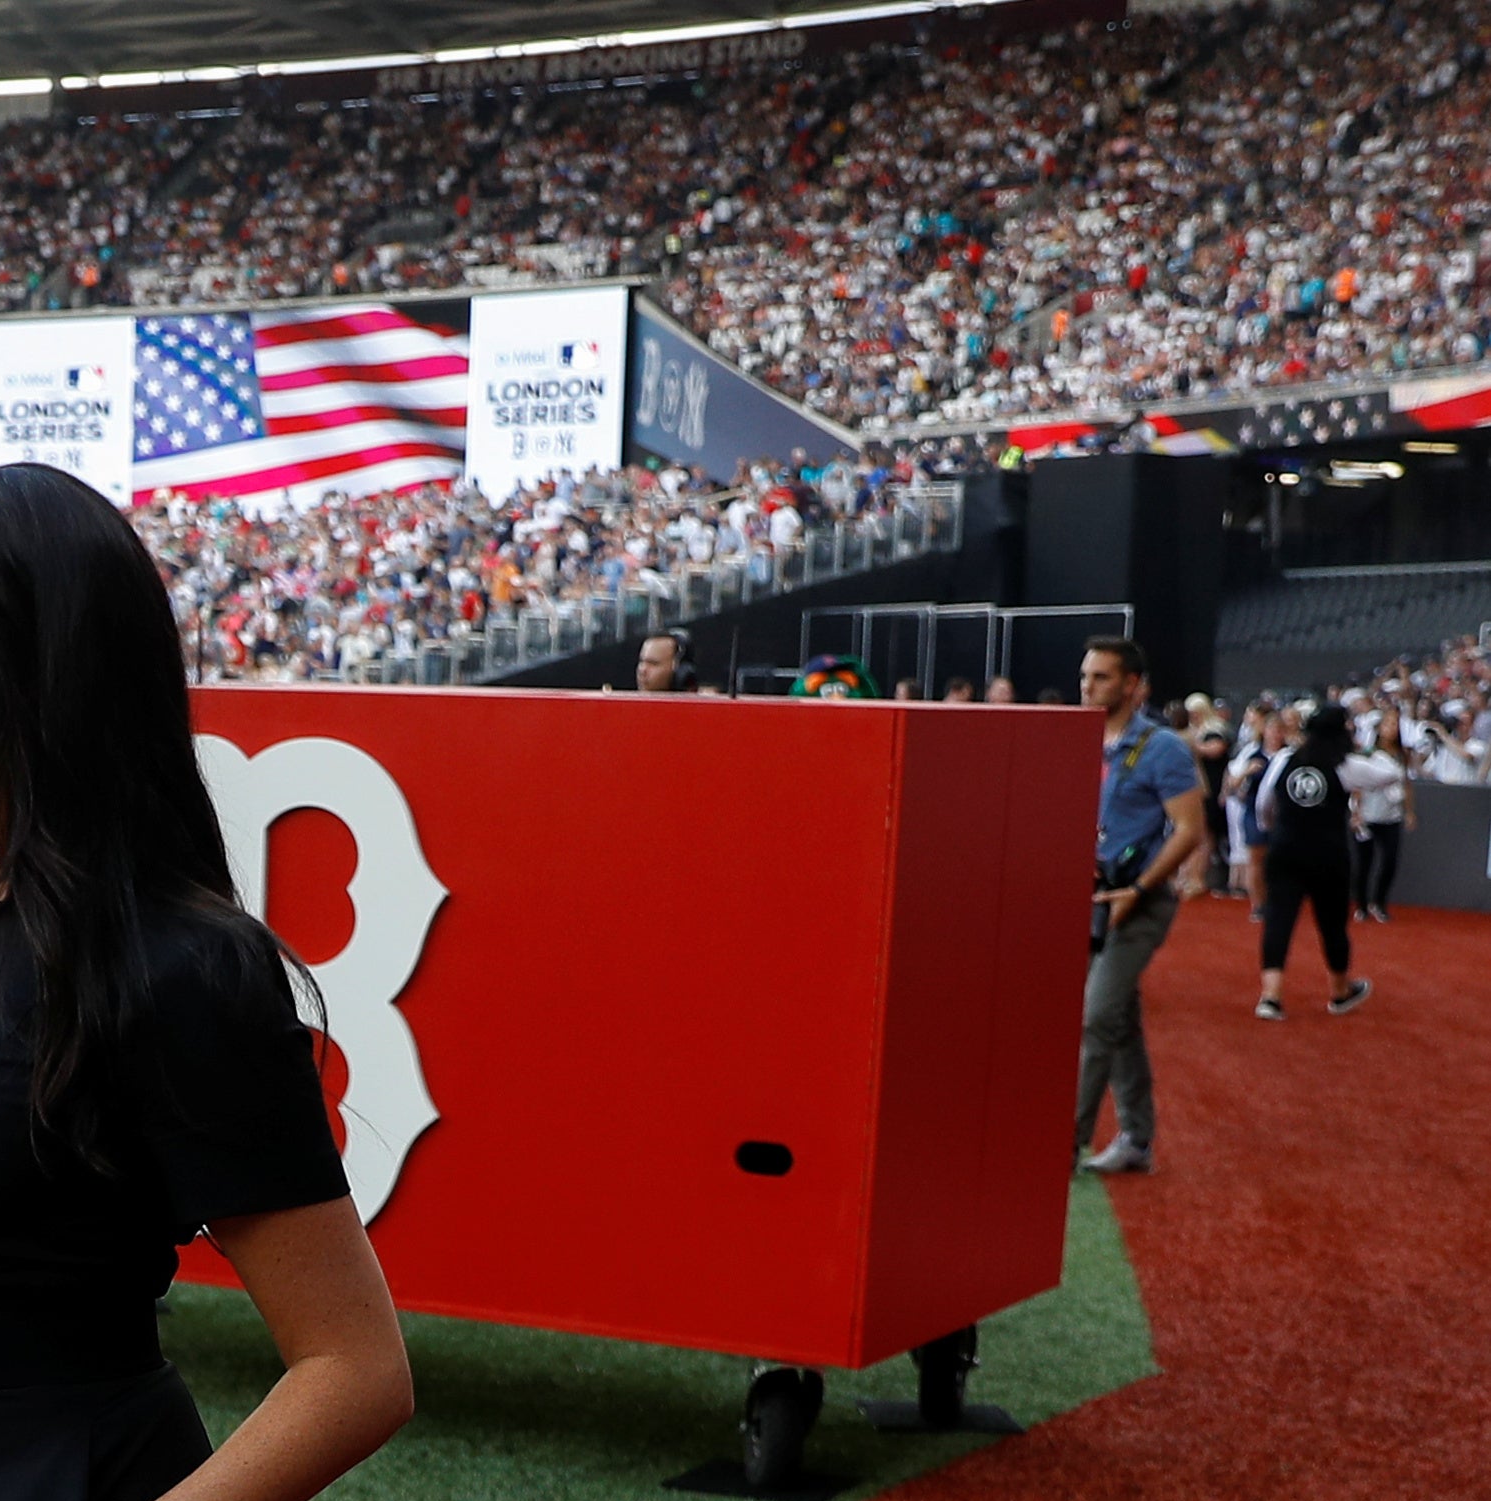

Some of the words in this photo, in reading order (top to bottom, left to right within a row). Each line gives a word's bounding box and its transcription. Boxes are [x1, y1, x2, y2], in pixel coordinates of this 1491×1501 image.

[707, 31, 806, 65] STAND
[487, 379, 604, 402] LONDON
[495, 403, 596, 425] SERIES
[3, 421, 104, 444] SERIES
